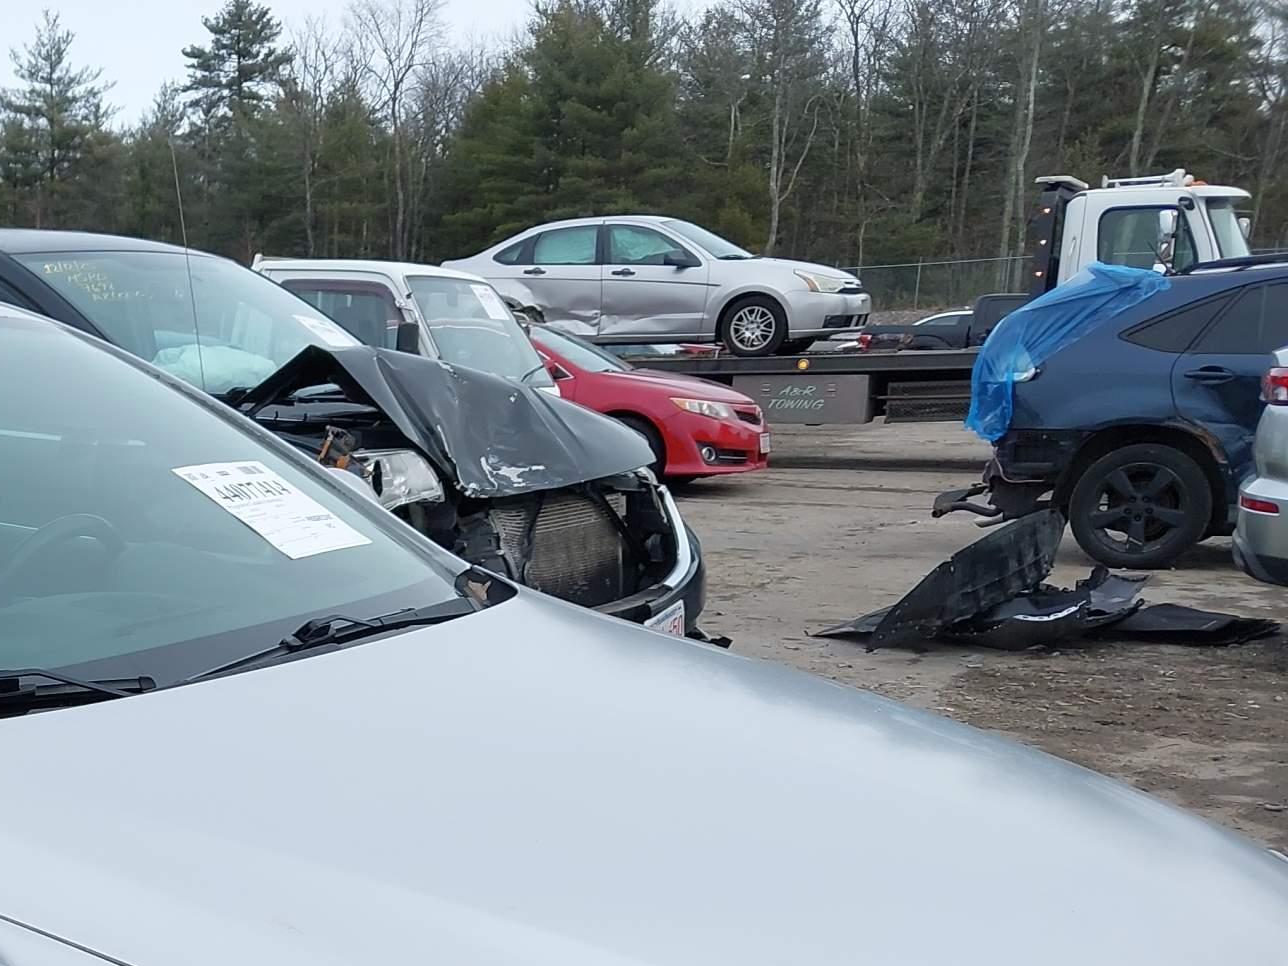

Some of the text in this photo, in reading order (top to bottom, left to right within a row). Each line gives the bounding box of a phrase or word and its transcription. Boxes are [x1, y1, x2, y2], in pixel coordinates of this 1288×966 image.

[779, 385, 817, 396] A&R
[768, 399, 825, 410] TOWING
[214, 480, 292, 502] 44077414
